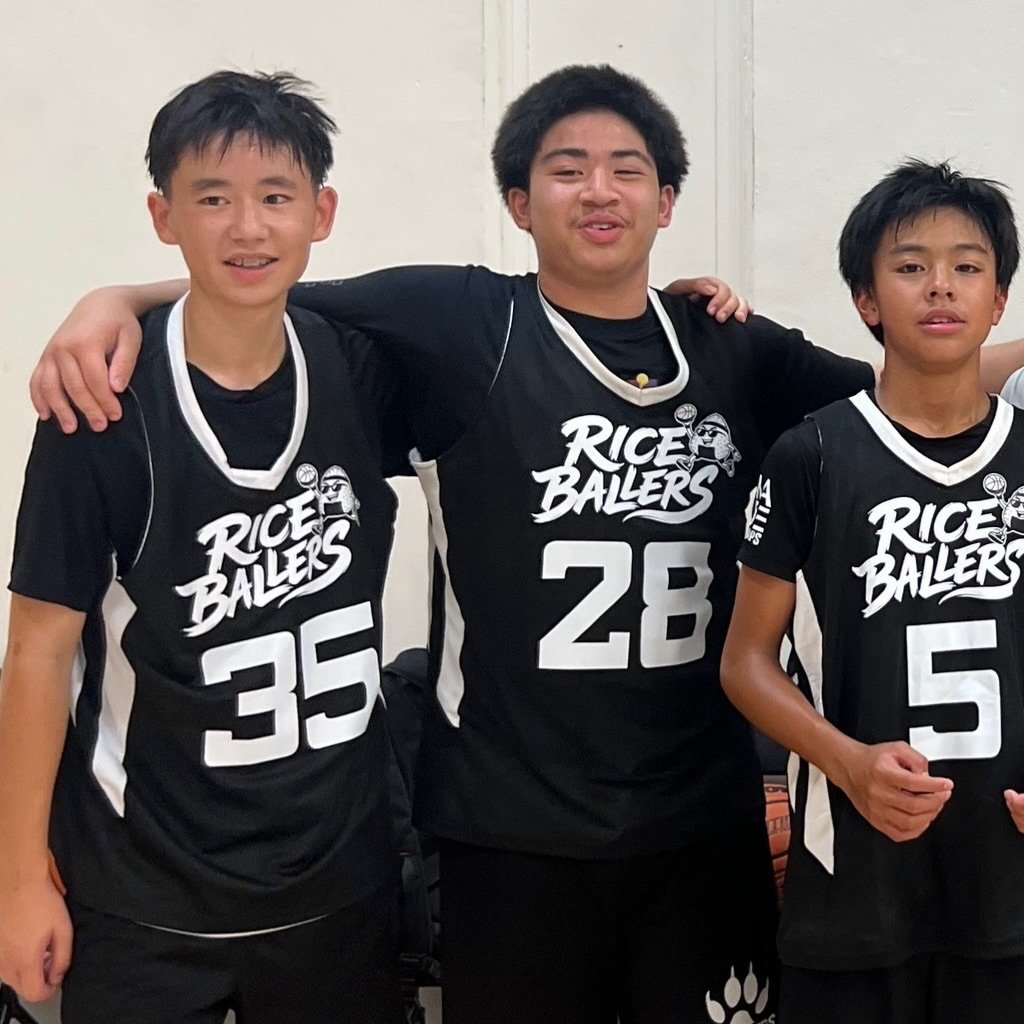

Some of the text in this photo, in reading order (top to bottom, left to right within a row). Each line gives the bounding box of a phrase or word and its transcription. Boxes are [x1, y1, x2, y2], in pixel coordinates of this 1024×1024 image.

[561, 415, 687, 472] RICE
[196, 492, 320, 571] RICE
[531, 465, 719, 524] BALLERS
[866, 497, 1000, 552] RICE
[173, 521, 352, 637] BALLERS
[538, 540, 714, 670] 28
[200, 601, 380, 767] 35
[906, 619, 1001, 761] 5
